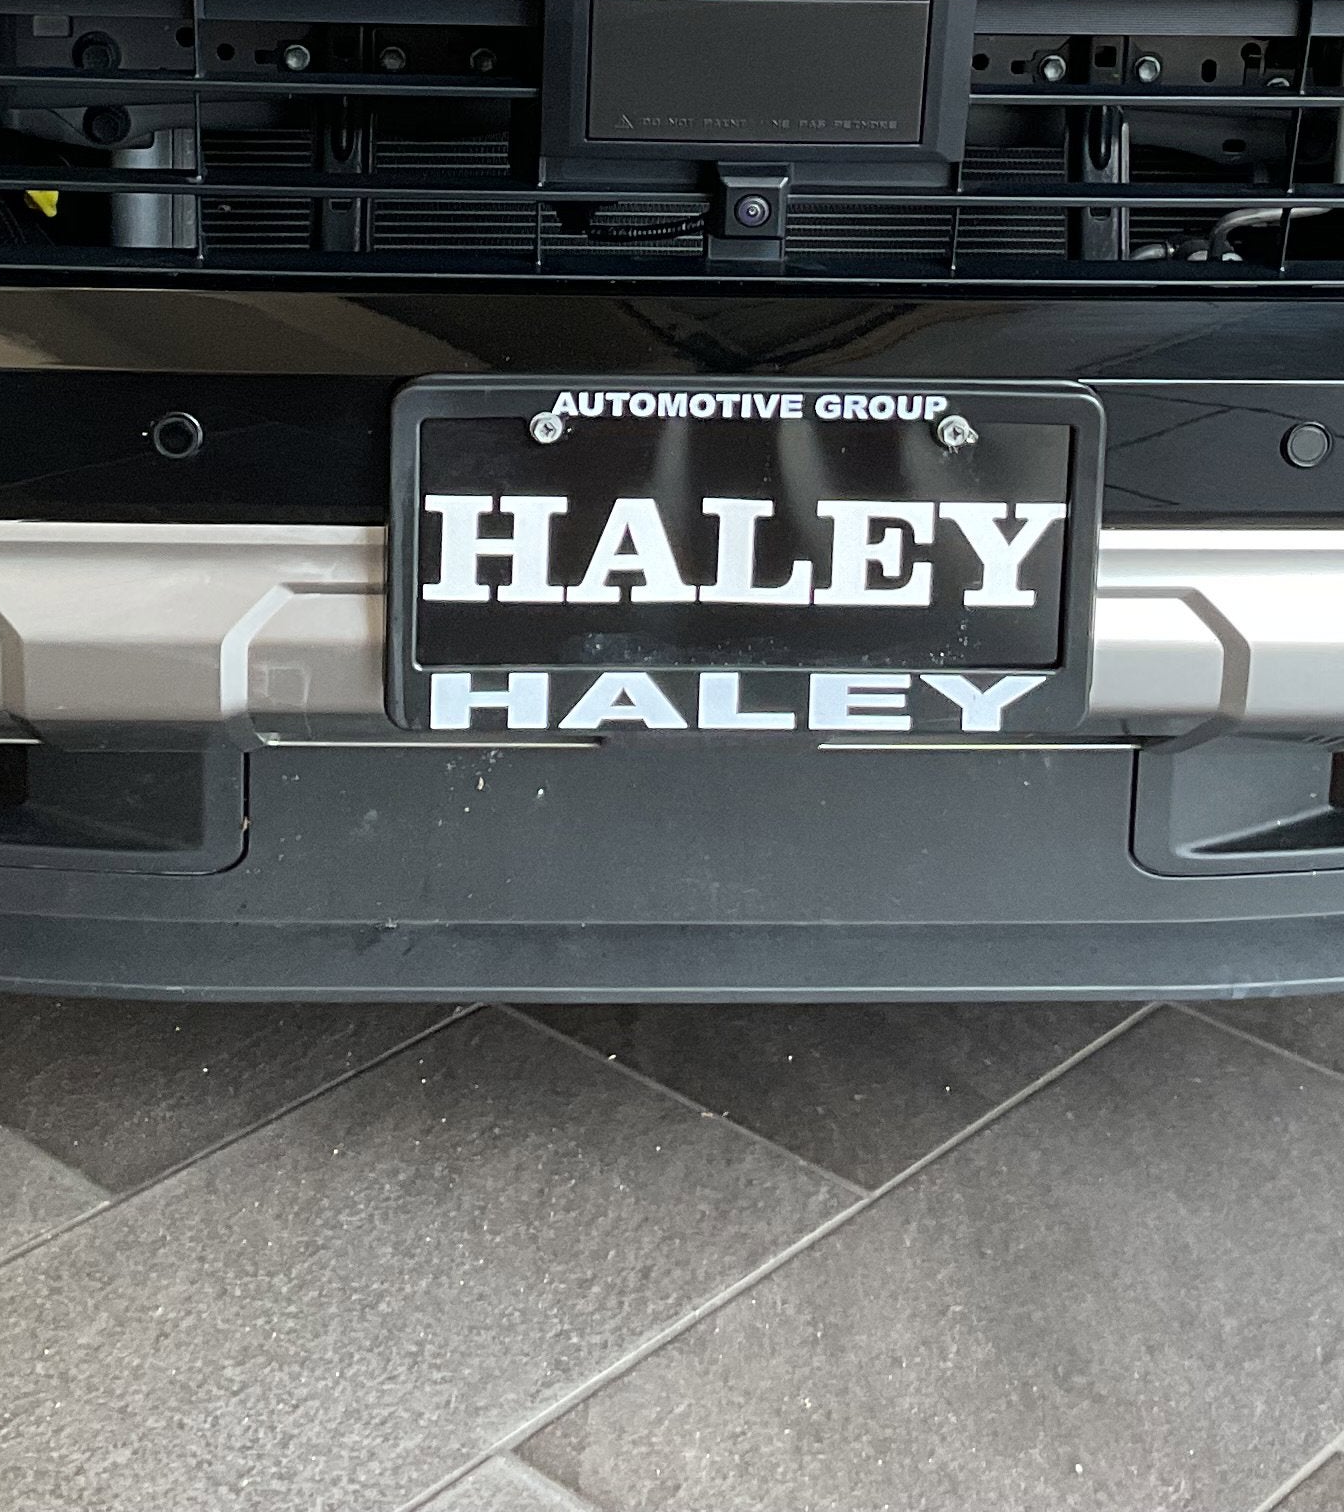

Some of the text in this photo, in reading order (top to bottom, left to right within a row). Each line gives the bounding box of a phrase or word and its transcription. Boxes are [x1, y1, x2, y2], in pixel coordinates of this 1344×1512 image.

[555, 391, 950, 421] AUTOMOTIVE GROUP
[421, 494, 1068, 607] HALEY
[429, 672, 1047, 732] HALEY
